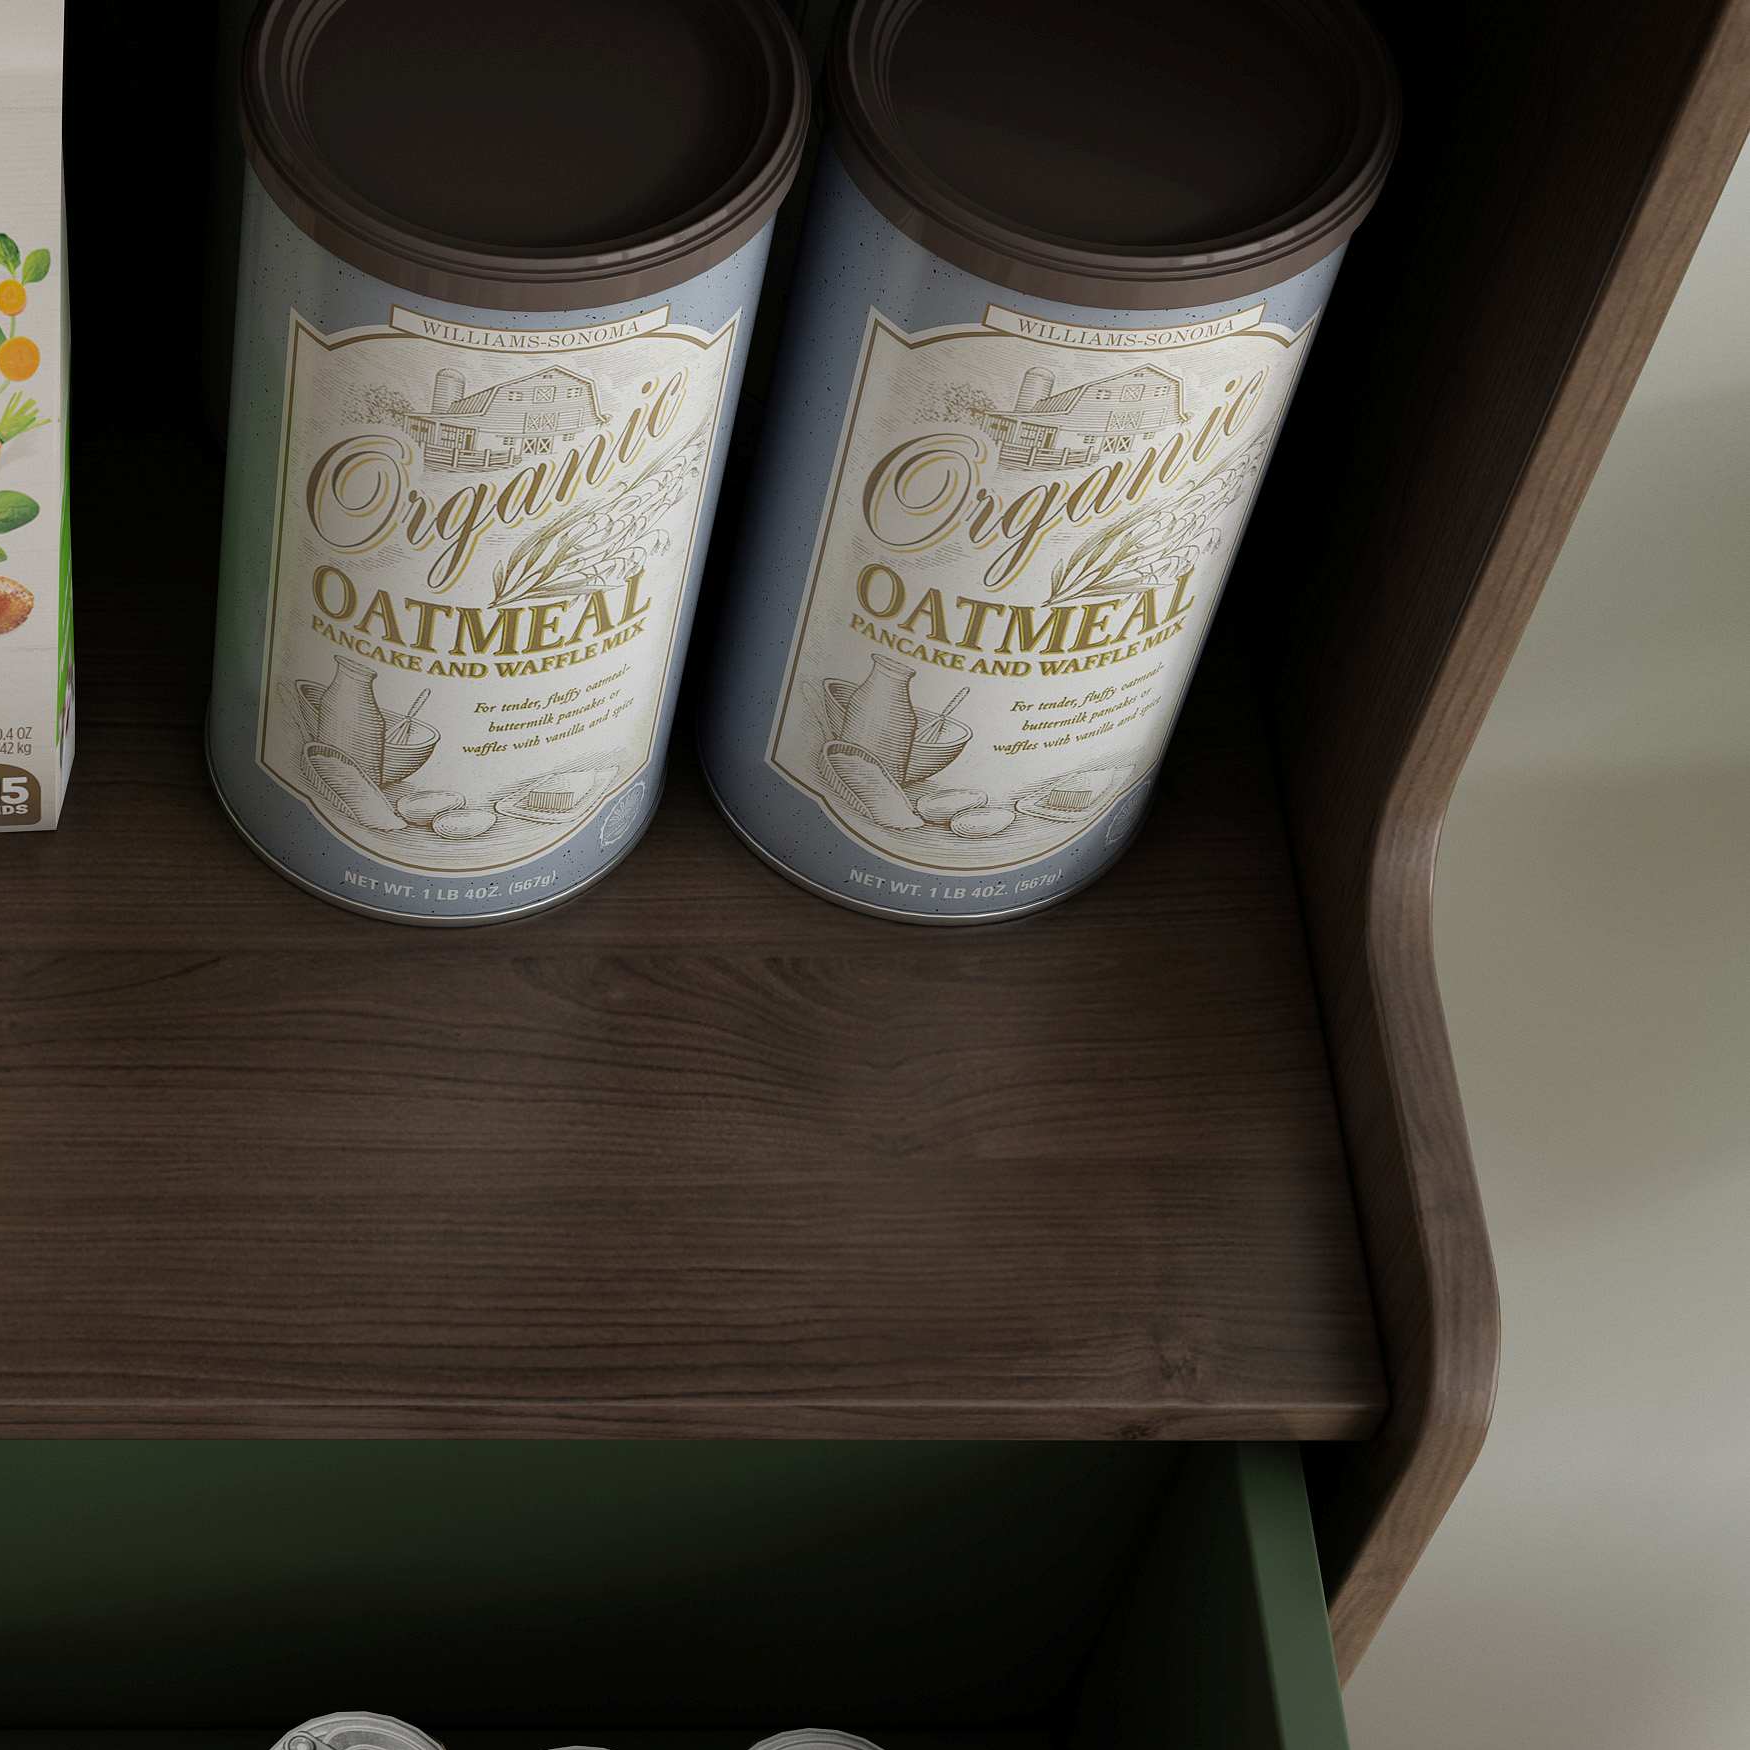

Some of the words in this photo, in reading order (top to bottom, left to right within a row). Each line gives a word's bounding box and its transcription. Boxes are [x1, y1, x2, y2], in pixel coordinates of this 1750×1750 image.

[423, 319, 641, 349] WILLIAMS-SONOMA
[1017, 318, 1235, 347] WILLIAMS-SONOMA
[306, 365, 689, 593] Organic
[863, 364, 1269, 591] Organic
[311, 564, 651, 657] OATMEAL
[857, 563, 1194, 655] OATMEAL
[311, 615, 422, 672] PANCAKE
[427, 659, 490, 679] AND
[494, 645, 596, 678] WAFFLE
[601, 616, 646, 655] MIX
[848, 613, 965, 670] PANCAKE
[969, 658, 1030, 677] AND
[1038, 643, 1139, 676] WAFFLE
[1142, 615, 1186, 653] MIX
[474, 702, 496, 713] For
[501, 698, 541, 712] tender,
[542, 688, 582, 709] fluffy
[586, 663, 631, 692] oatmeal-
[1010, 701, 1034, 712] For
[1038, 697, 1078, 710] tender,
[1078, 687, 1117, 708] fluffy
[1022, 712, 1087, 731] buttermilk
[1089, 695, 1138, 724] pancakes
[1141, 688, 1152, 698] or
[462, 742, 507, 756] waffles
[512, 735, 540, 750] with
[546, 724, 585, 743] vanilla
[589, 712, 608, 729] and
[612, 697, 634, 717] spice
[488, 713, 554, 732] buttermilk
[556, 697, 606, 724] pancakes
[610, 689, 621, 700] or
[17, 727, 32, 739] OZ
[17, 742, 32, 756] kg
[993, 740, 1038, 755] waffles
[1043, 734, 1071, 748] with
[1075, 722, 1114, 742] vanilla
[1117, 711, 1138, 727] and
[344, 870, 378, 890] NET
[383, 881, 416, 898] WT.
[423, 889, 431, 899] 1
[437, 889, 459, 901] LB
[508, 870, 556, 895] (567g)
[849, 869, 886, 889] NET
[890, 881, 922, 897] WT.
[929, 888, 937, 898] 1
[944, 887, 966, 899] LB
[1014, 868, 1062, 894] (567g)
